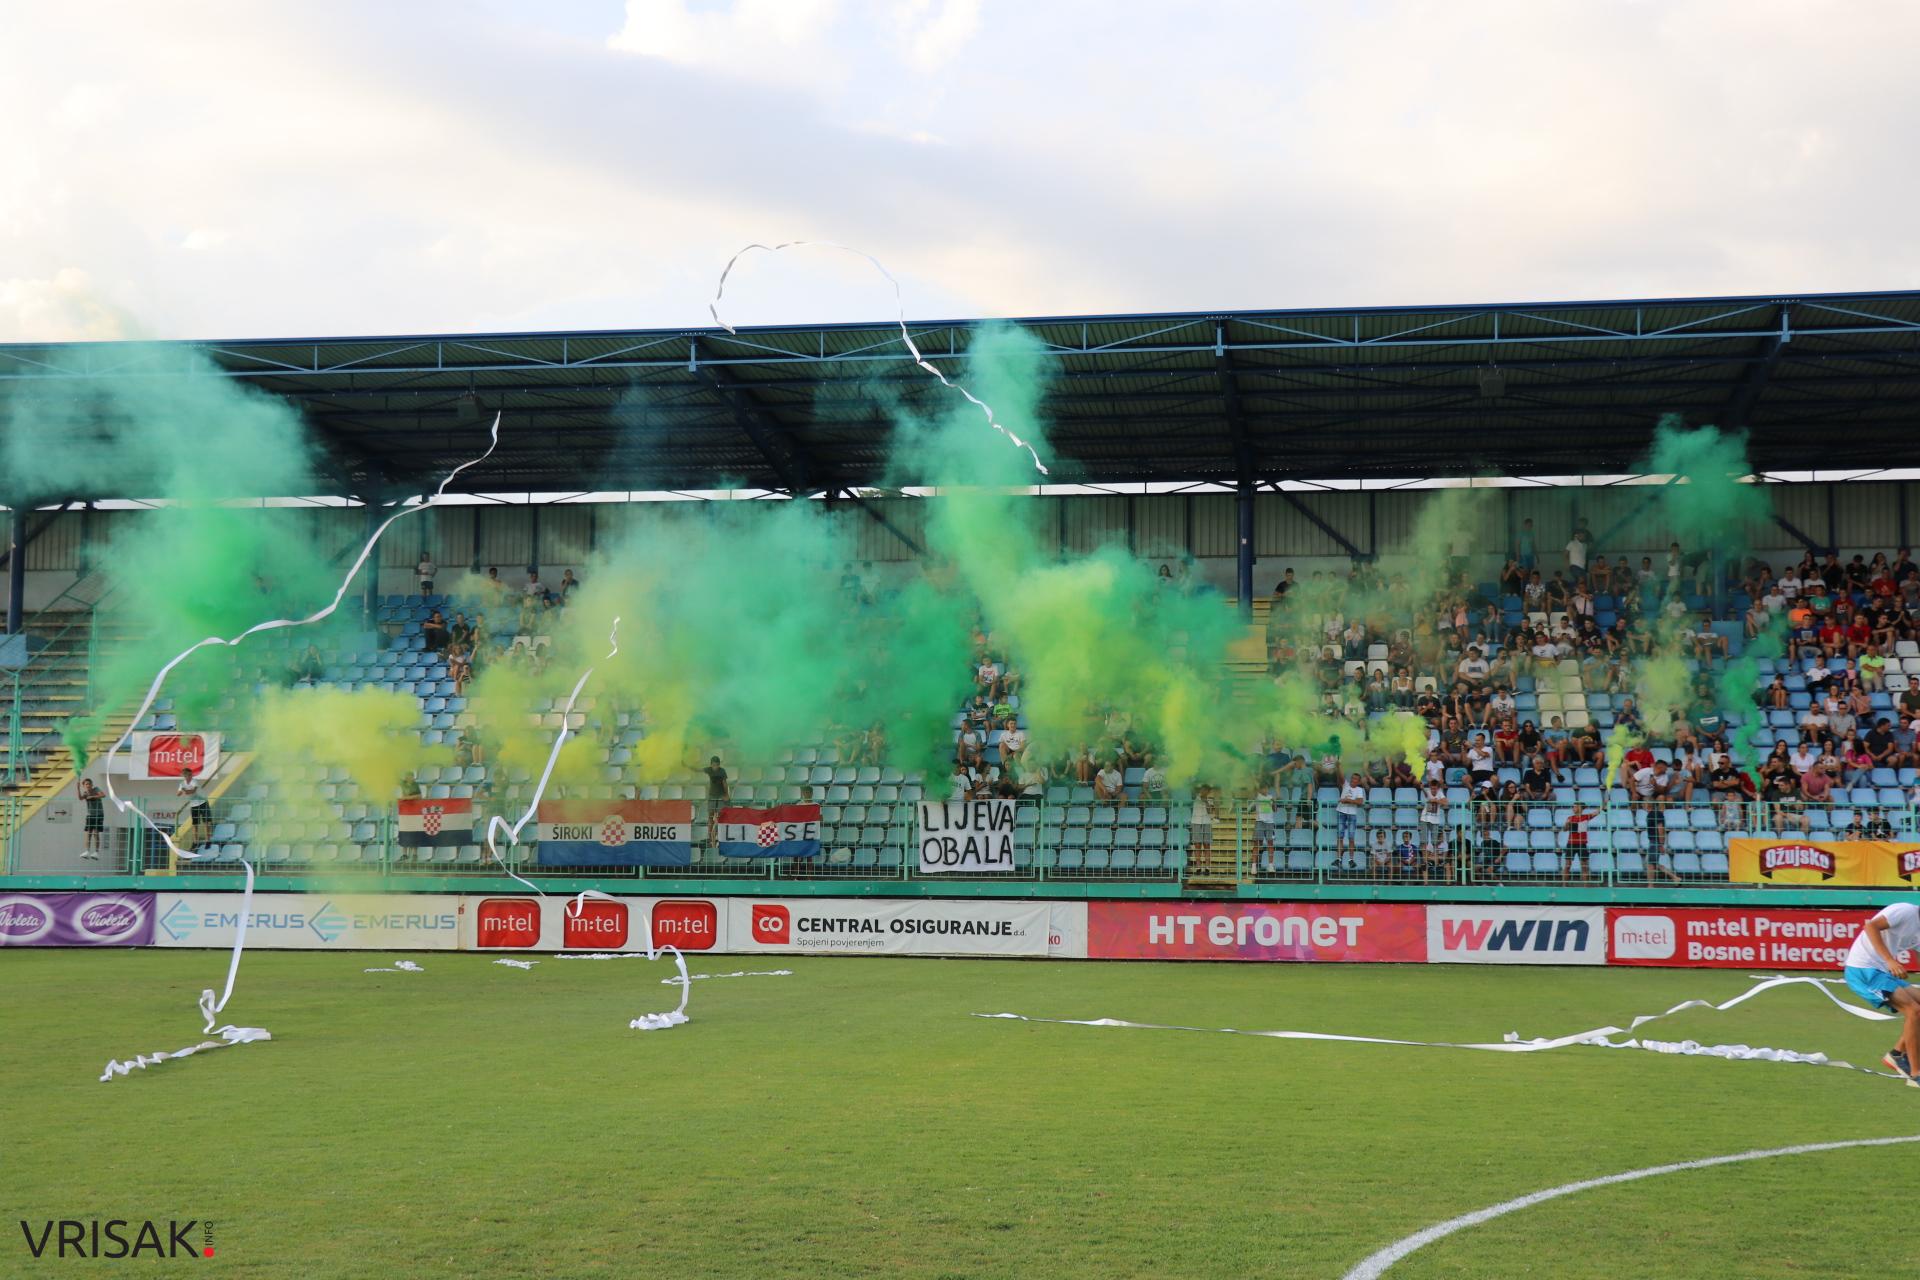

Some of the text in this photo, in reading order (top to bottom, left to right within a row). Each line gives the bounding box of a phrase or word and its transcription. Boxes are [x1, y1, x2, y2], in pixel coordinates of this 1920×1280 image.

[154, 747, 198, 763] m:tel
[923, 801, 1014, 832] LIJEVA
[552, 824, 676, 840] ŠIROKI BRIJEG
[923, 835, 1013, 865] OBALA
[1765, 846, 1830, 869] Ožujsko
[0, 911, 40, 927] Violeta
[87, 911, 131, 927] Violeta
[204, 913, 304, 928] EMERUS
[353, 915, 456, 929] EMERUS
[484, 913, 533, 931] m:tel
[571, 915, 621, 933] m:tel
[659, 915, 709, 934] m:tel
[759, 917, 784, 932] CO
[797, 917, 885, 934] CENTRAL
[890, 919, 1012, 936] OSIGURANJE
[1149, 916, 1201, 944] HT
[1622, 929, 1668, 945] m:tel
[1687, 917, 1860, 942] m:tel Premijer
[797, 937, 885, 948] Spojeni povjerenjem
[1688, 942, 1754, 961] Bosne
[1760, 943, 1767, 960] i
